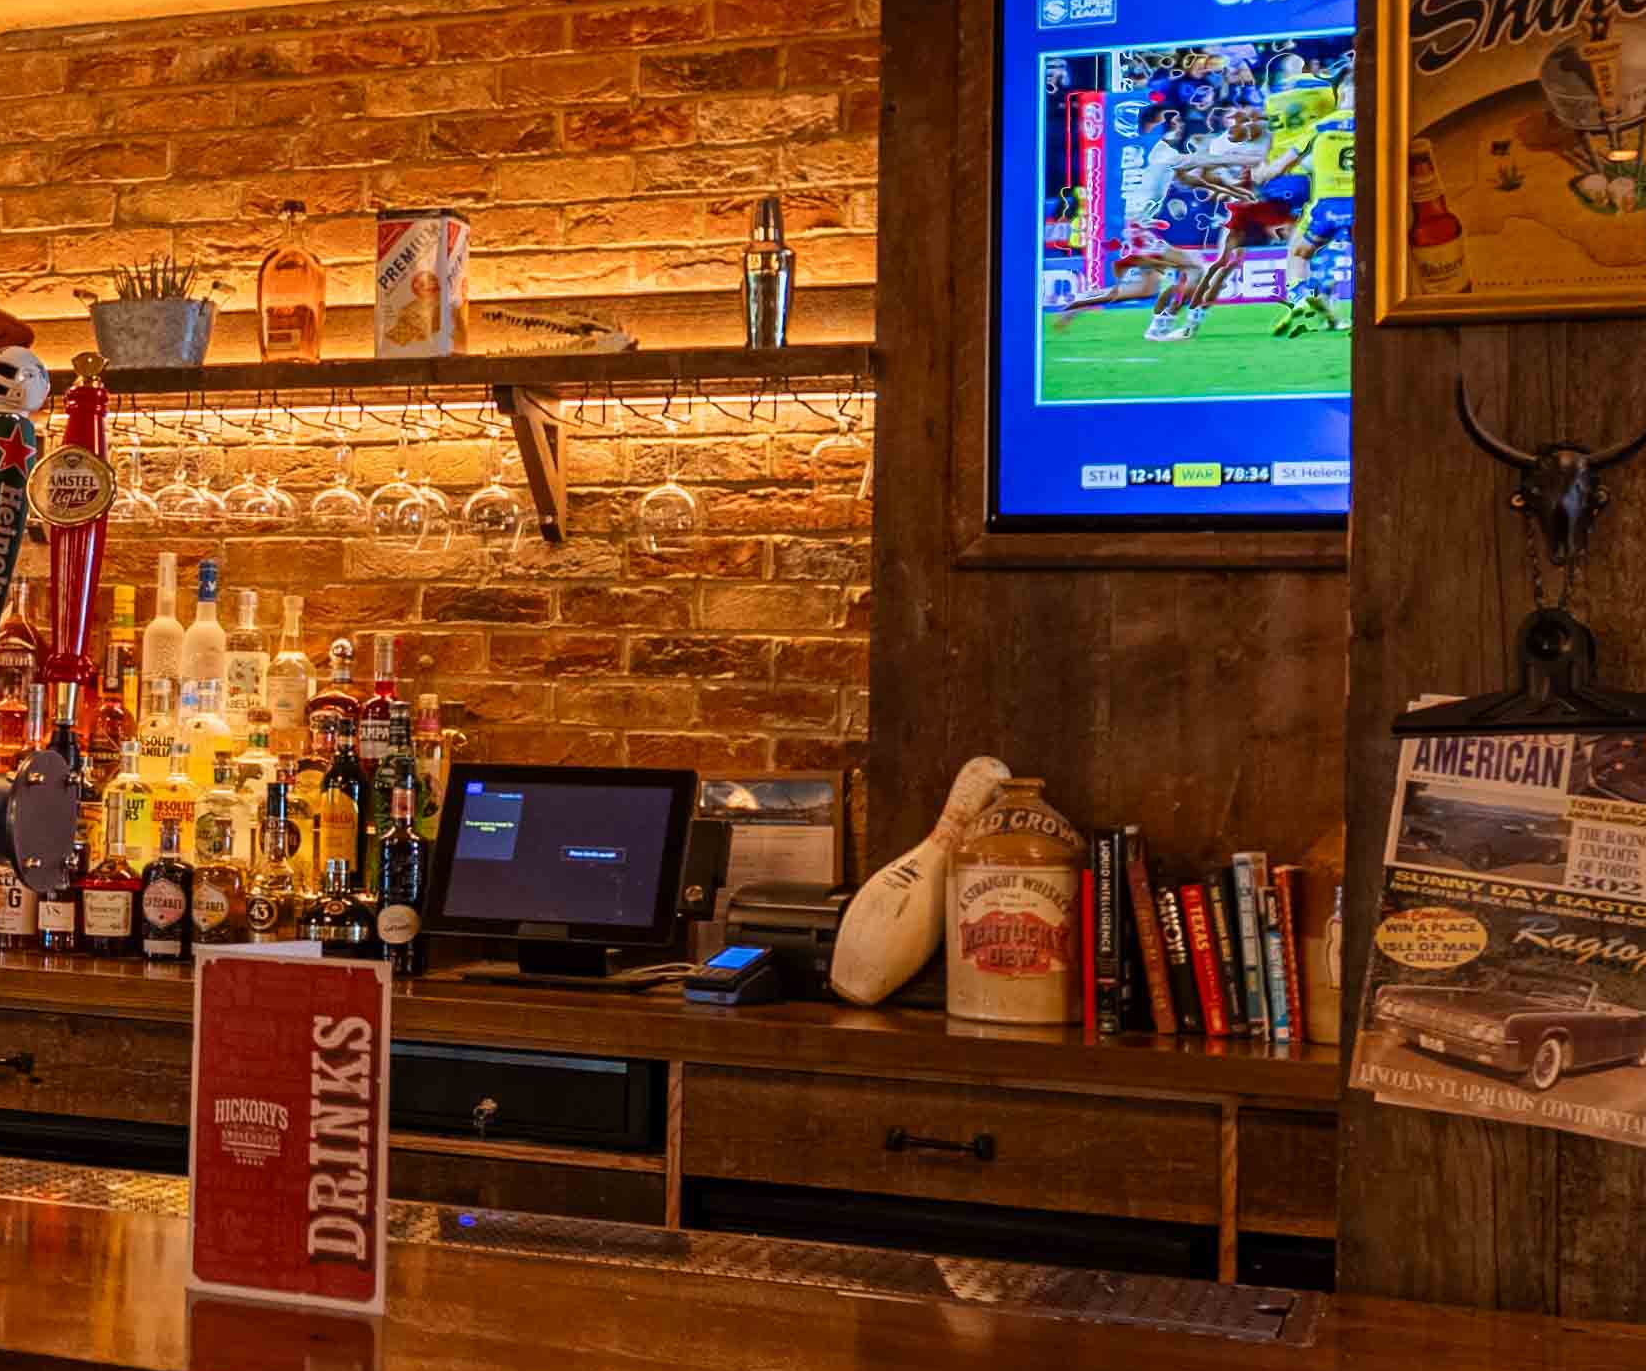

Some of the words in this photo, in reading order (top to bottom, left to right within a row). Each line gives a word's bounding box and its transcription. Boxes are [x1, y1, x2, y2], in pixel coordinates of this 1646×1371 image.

[1070, 6, 1112, 20] LEAGUE
[378, 221, 440, 290] PREMIUM
[48, 475, 97, 488] AMSTEL
[1181, 468, 1214, 481] WAR
[1413, 736, 1566, 790] AMERICAN
[1570, 799, 1609, 812] TONY
[1394, 870, 1486, 892] SUNNY
[1491, 884, 1550, 903] DAY
[1571, 875, 1644, 897] 302
[251, 899, 268, 920] 43
[1191, 903, 1210, 951] TEXAS
[1385, 923, 1413, 933] WIN
[1418, 923, 1428, 933] A
[1430, 922, 1477, 933] PLACE
[1382, 942, 1414, 951] ISLE
[1419, 942, 1439, 951] OF
[1443, 942, 1479, 951] MAN
[308, 1015, 373, 1262] DRINKS
